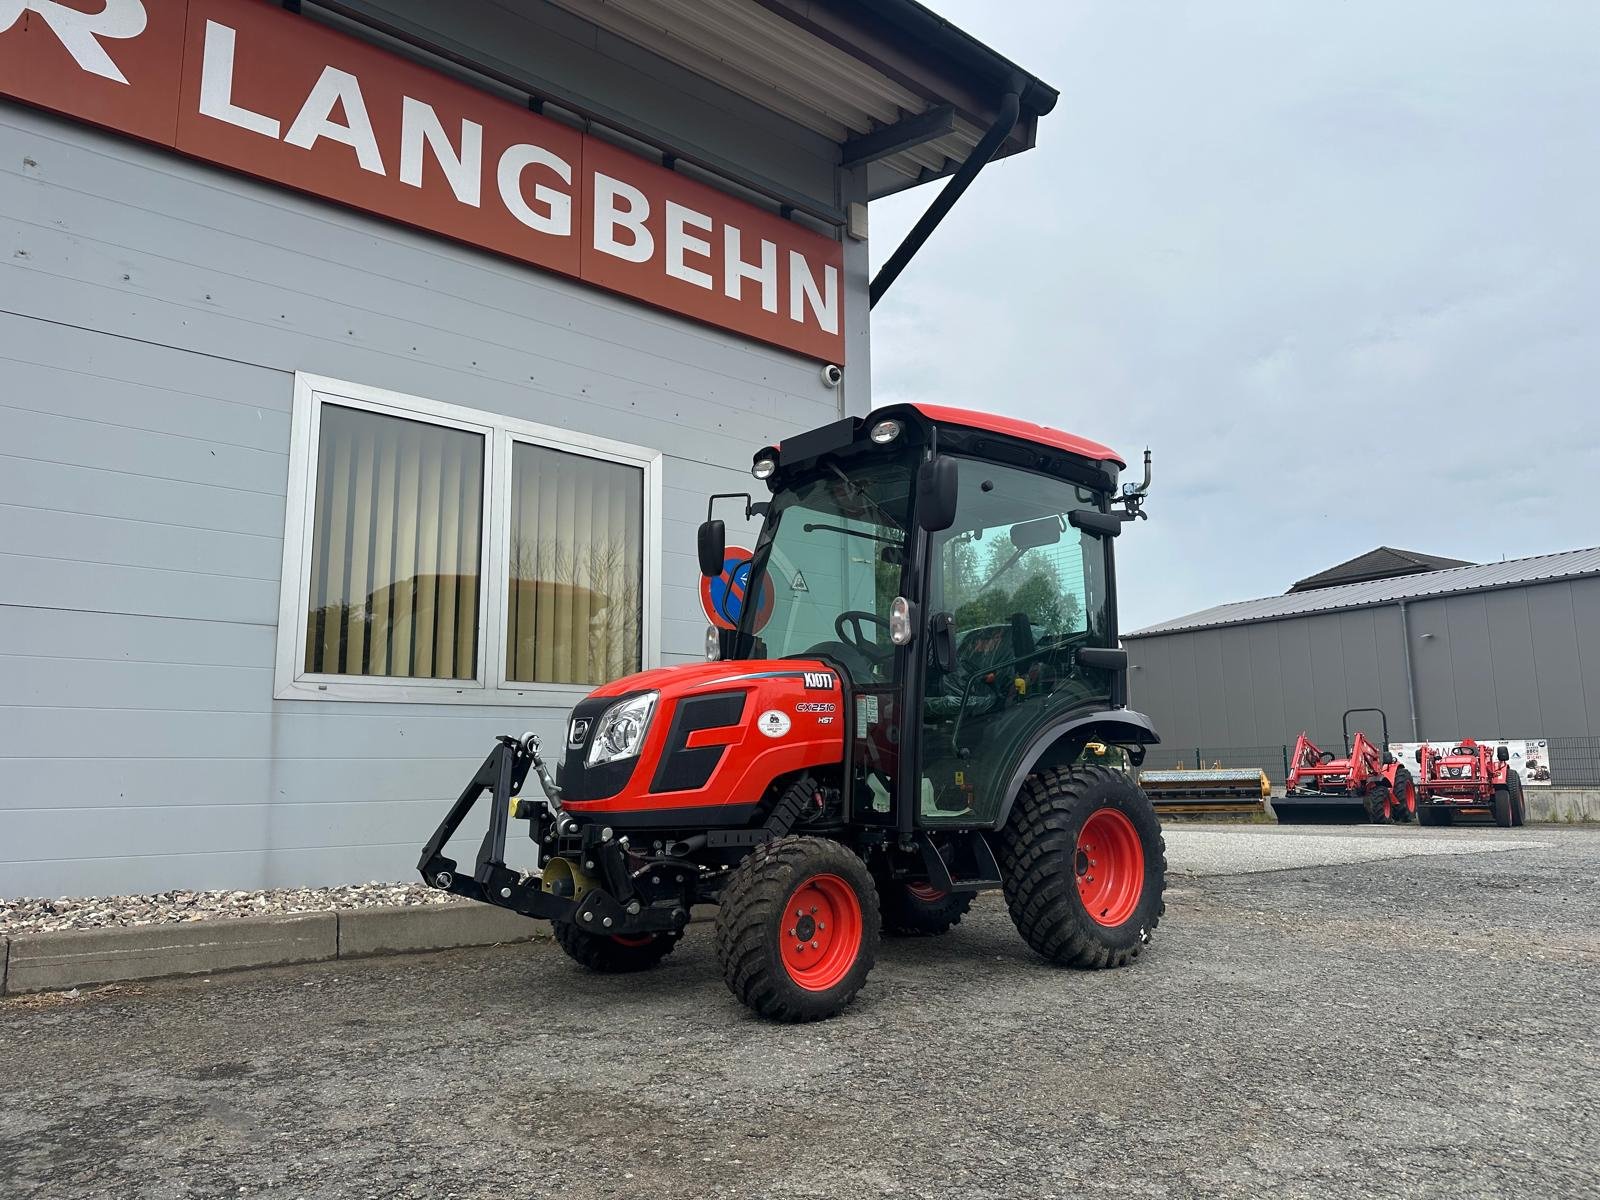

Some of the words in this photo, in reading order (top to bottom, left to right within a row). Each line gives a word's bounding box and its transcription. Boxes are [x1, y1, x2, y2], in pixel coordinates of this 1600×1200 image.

[198, 18, 839, 336] LANGBEHN
[804, 672, 833, 688] KIOTI
[796, 703, 836, 712] CX2510
